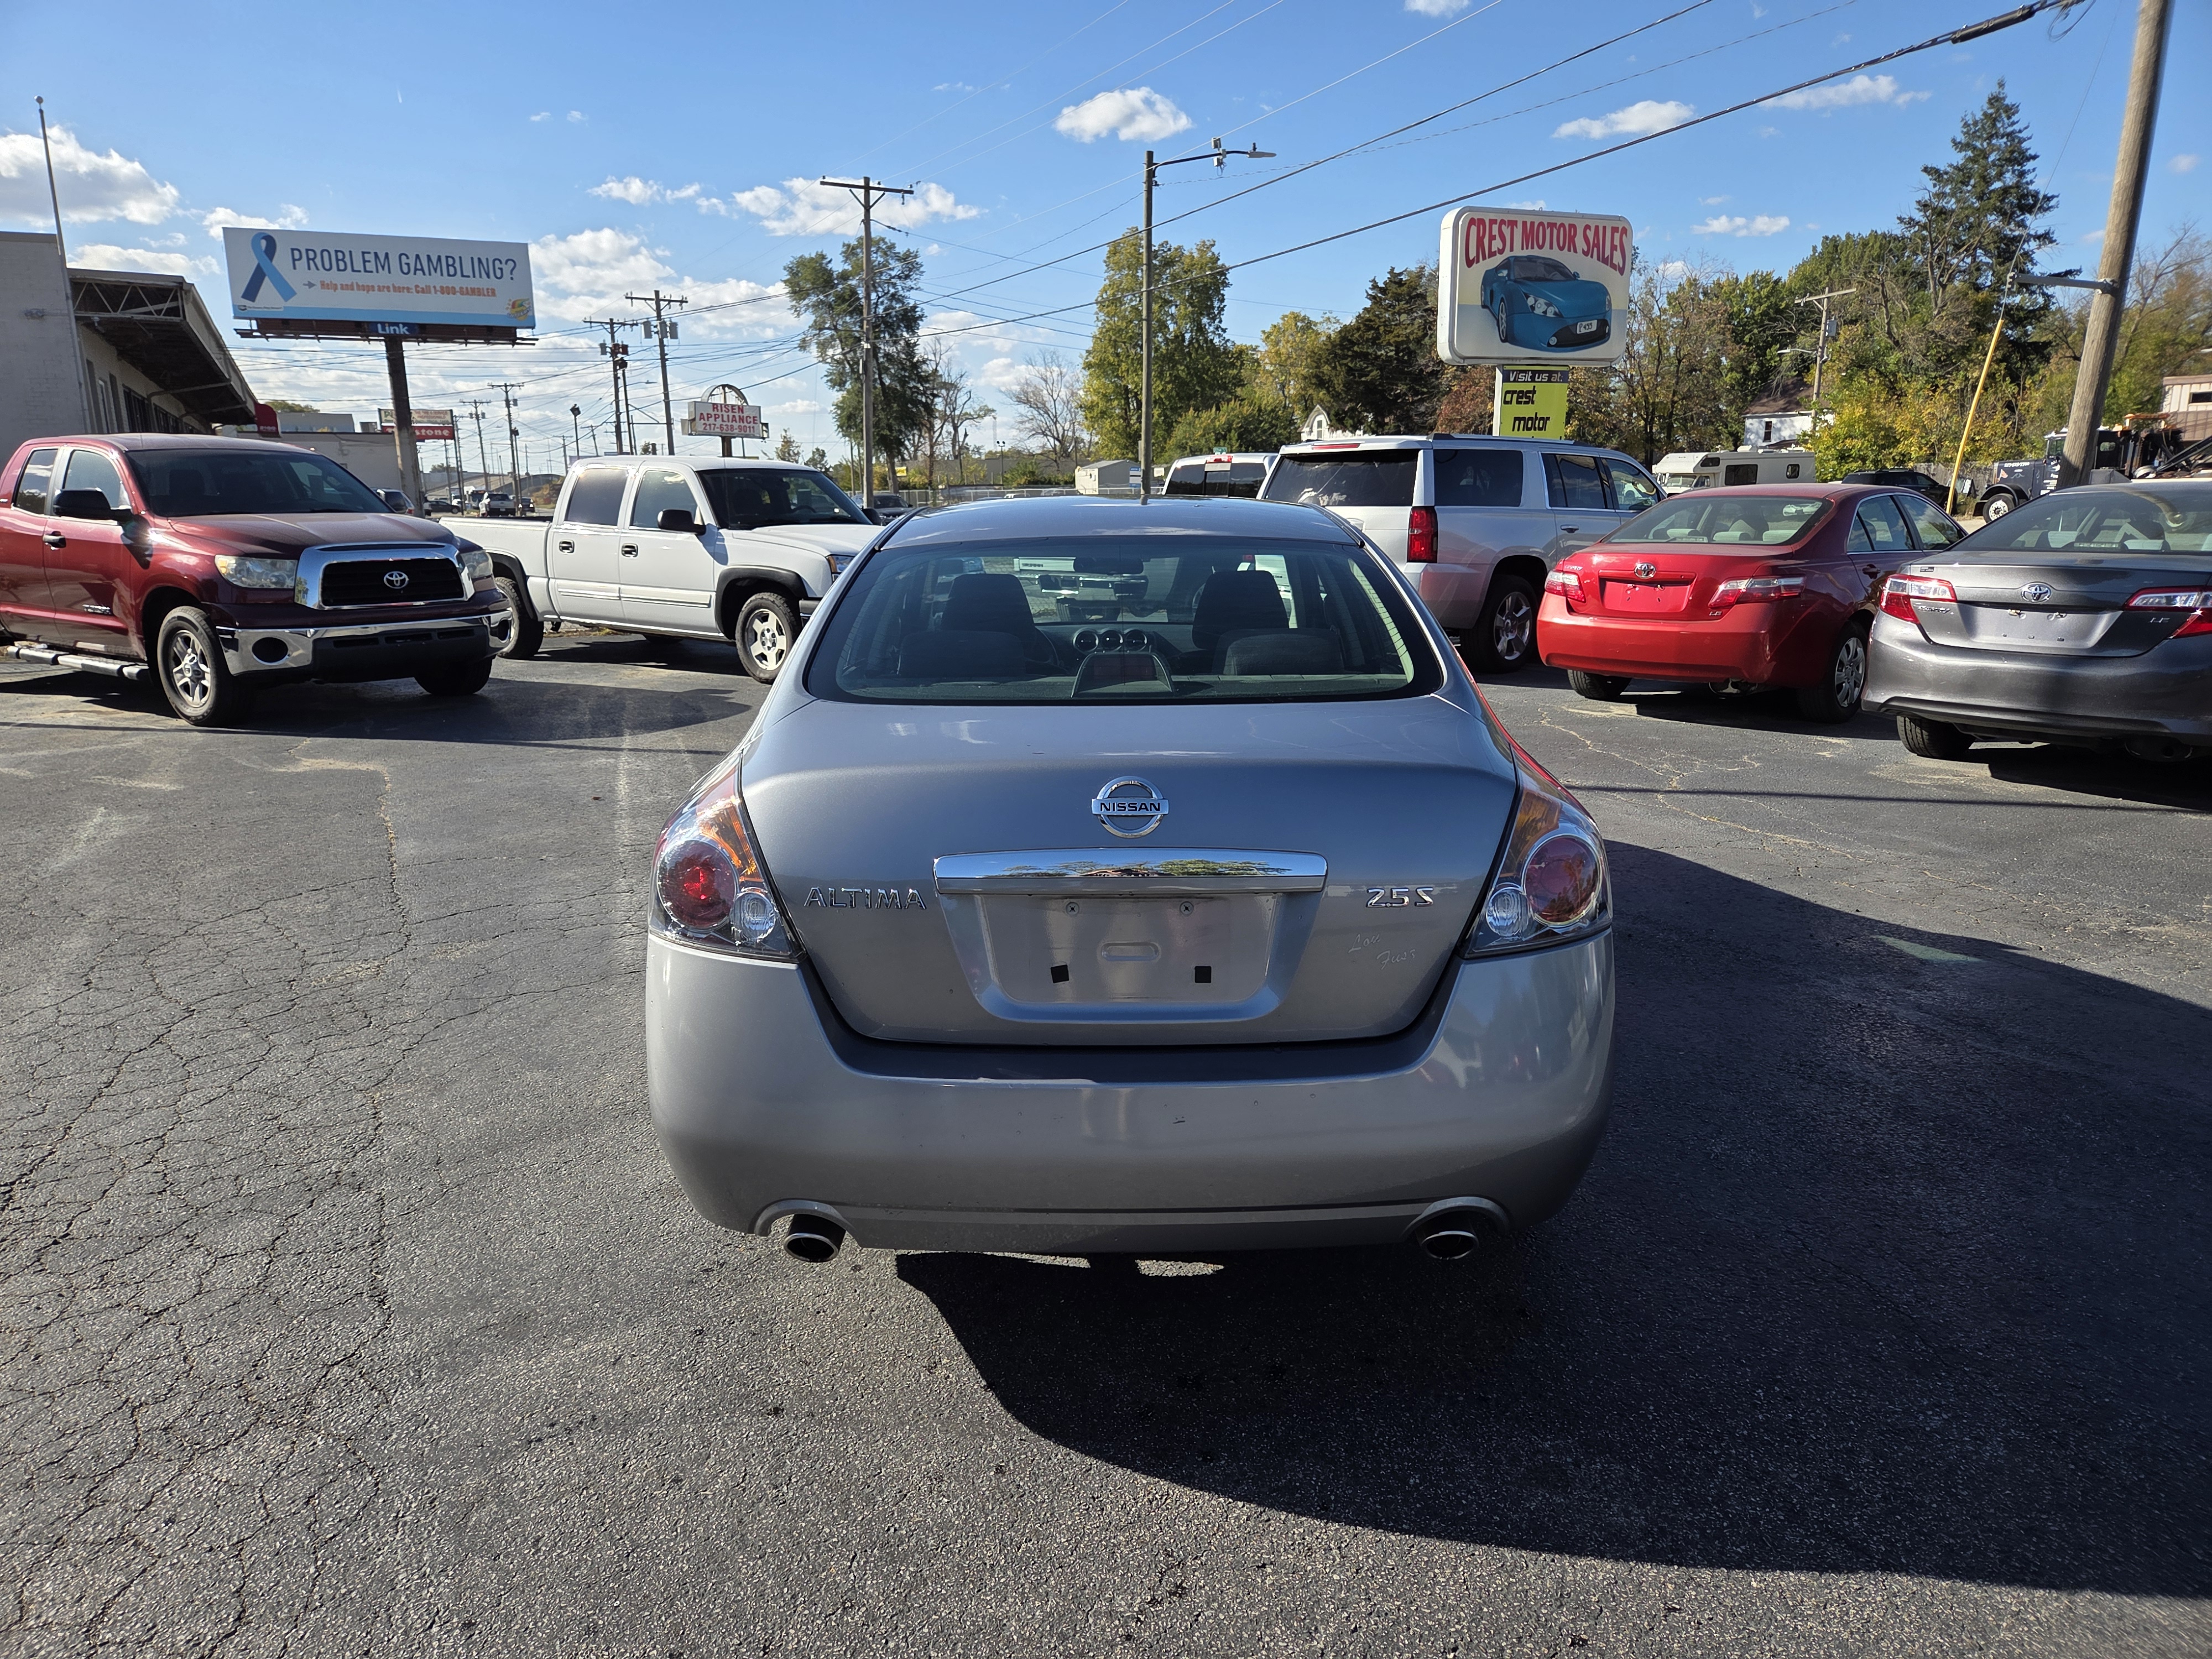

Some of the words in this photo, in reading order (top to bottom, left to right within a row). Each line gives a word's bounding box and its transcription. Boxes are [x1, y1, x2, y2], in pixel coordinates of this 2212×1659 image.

[1465, 217, 1517, 268] CREST
[1521, 220, 1578, 254] MOTOR
[1582, 224, 1627, 276] SALES
[290, 248, 390, 274] PROBLEM
[398, 253, 518, 281] GAMBLING?
[320, 280, 338, 292] Help
[340, 281, 354, 291] and
[356, 281, 375, 294] hope
[377, 284, 391, 293] are
[392, 283, 414, 294] here:
[415, 284, 431, 294] Call
[432, 285, 497, 297] 1-800-GAMBLER
[377, 323, 410, 335] Link
[1510, 371, 1532, 382] Visit
[1535, 373, 1549, 382] us
[1551, 372, 1563, 382] at:
[1503, 385, 1536, 405] crest
[712, 404, 744, 414] RISEN
[699, 413, 758, 424] APPLIANCE
[1512, 412, 1550, 431] motor
[703, 423, 755, 433] 217-638-9011
[1100, 802, 1160, 812] NISSAN
[804, 886, 927, 910] ALTIMA
[1366, 887, 1409, 907] 2.5
[1414, 886, 1434, 907] S
